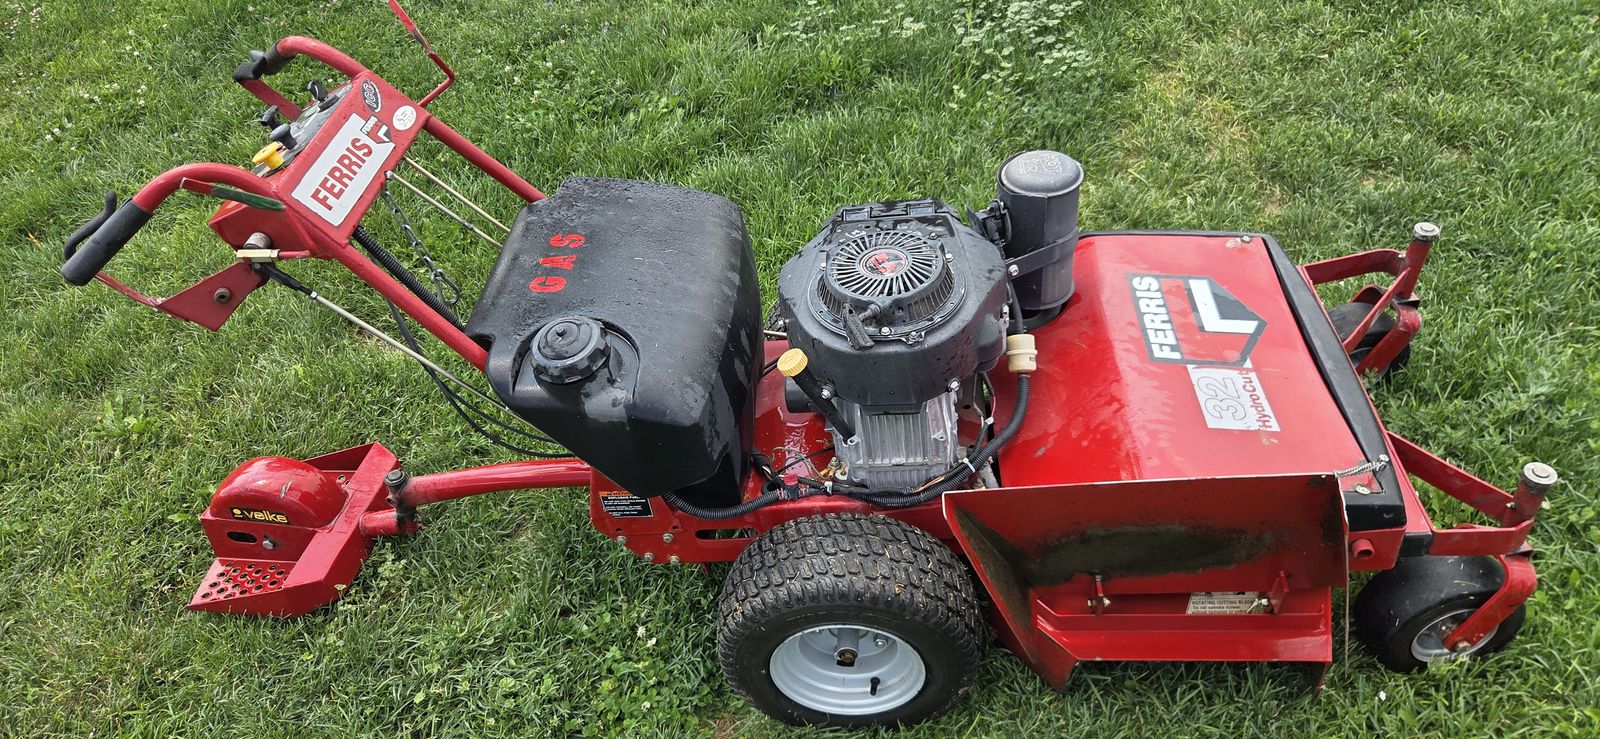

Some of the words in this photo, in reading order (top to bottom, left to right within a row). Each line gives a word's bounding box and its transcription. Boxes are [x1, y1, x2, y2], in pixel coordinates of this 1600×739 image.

[362, 116, 377, 135] FERRIS
[310, 137, 373, 211] FERRIS
[528, 233, 586, 293] GAS
[1132, 276, 1182, 360] FERRIS
[1197, 376, 1247, 421] 32
[1238, 369, 1273, 430] HydroCut
[243, 510, 288, 523] velke
